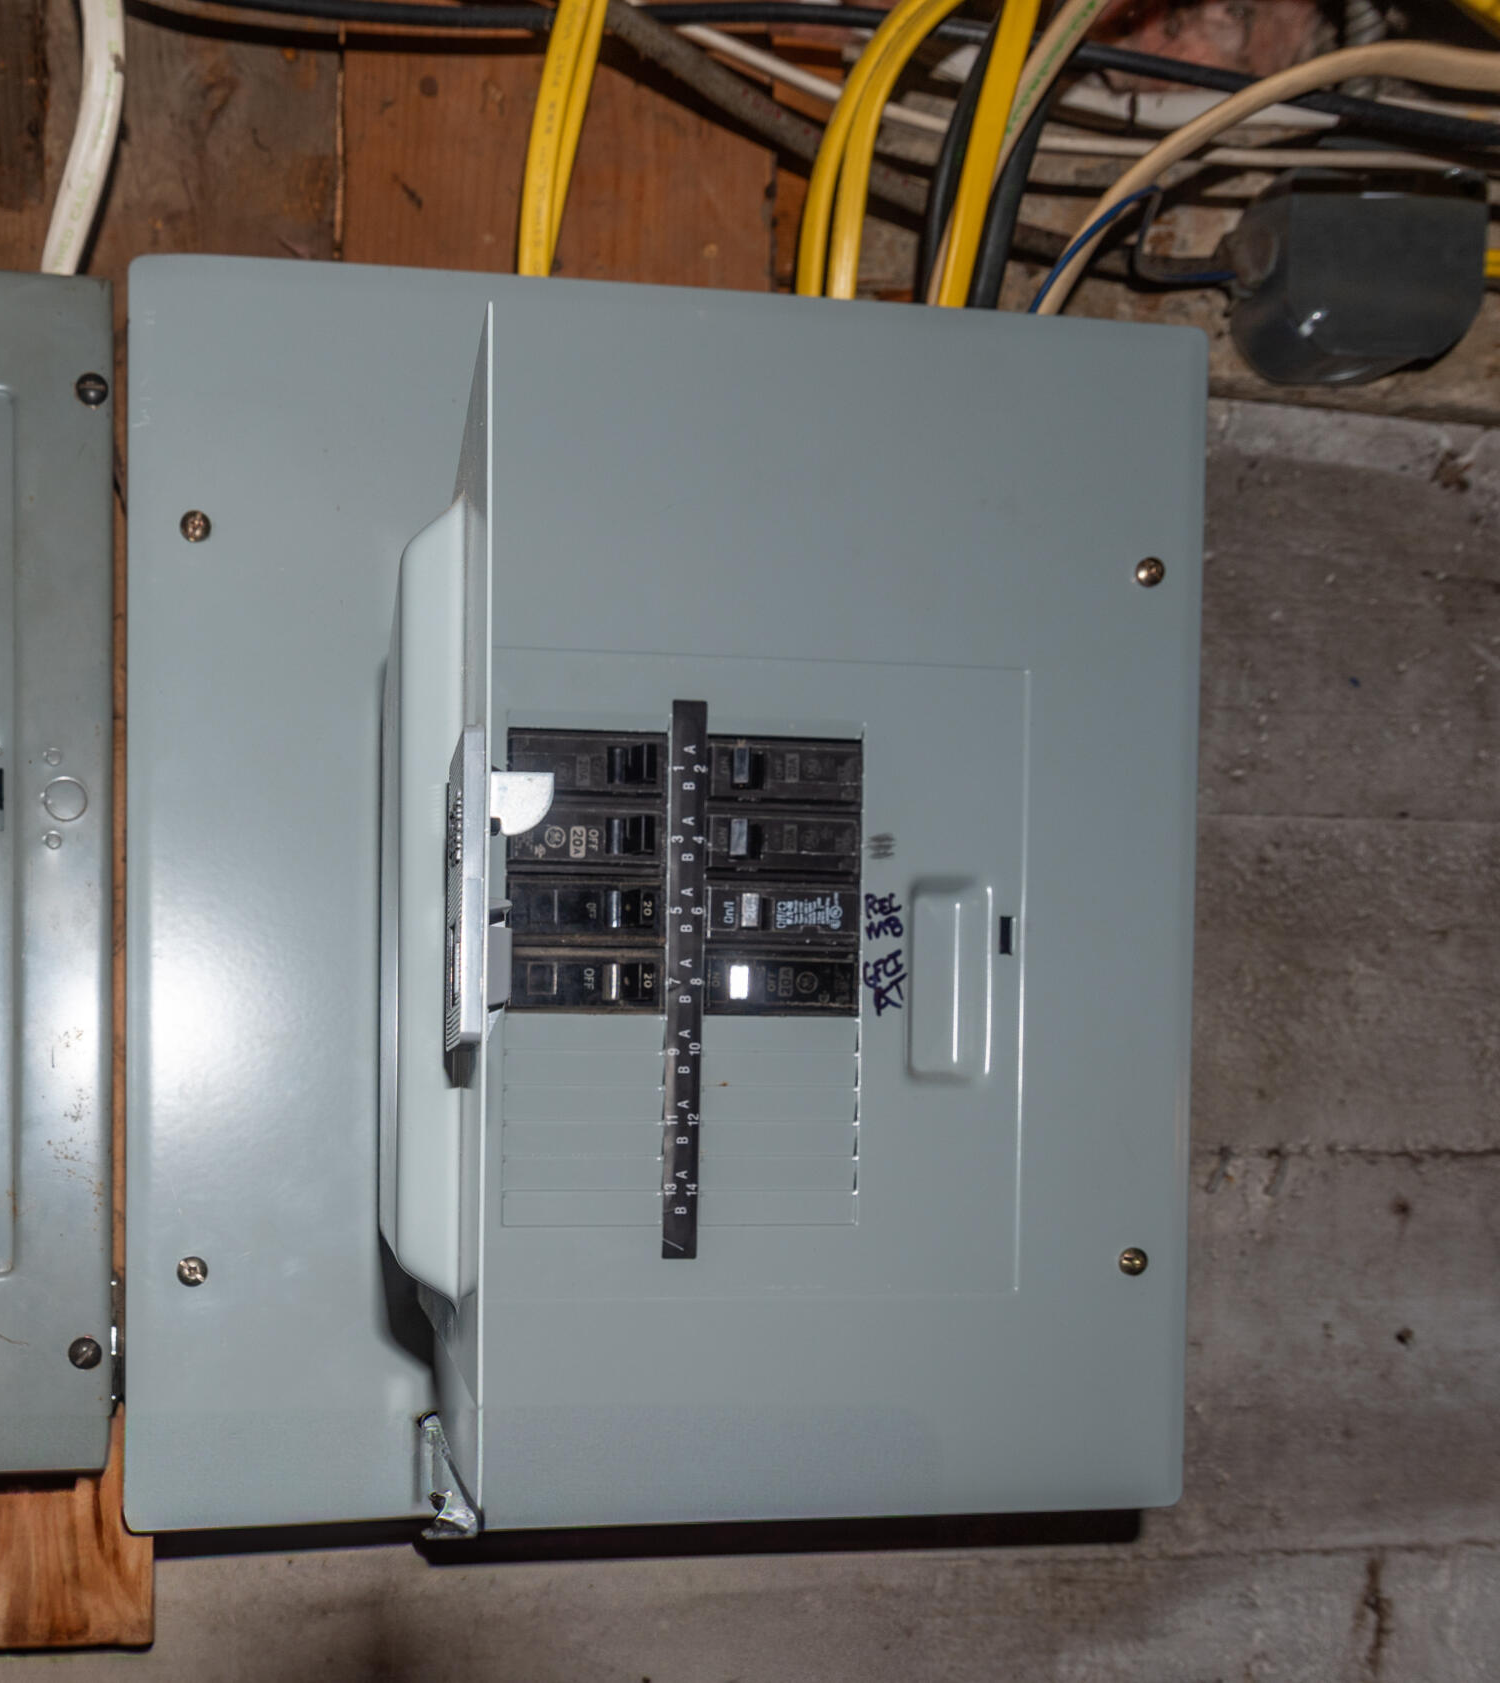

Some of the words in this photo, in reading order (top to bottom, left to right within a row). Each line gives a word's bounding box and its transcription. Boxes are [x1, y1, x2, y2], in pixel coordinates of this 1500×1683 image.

[684, 744, 696, 755] A
[673, 765, 685, 773] 1
[682, 816, 695, 826] A
[587, 828, 599, 852] OFF
[681, 853, 694, 862] B
[643, 900, 653, 917] 20
[670, 906, 683, 916] 5
[680, 924, 693, 933] B
[583, 967, 595, 991] OFF
[643, 972, 653, 989] 20
[690, 977, 703, 986] 8
[678, 1029, 691, 1039] A
[667, 1047, 680, 1057] 9
[687, 1113, 700, 1126] 12
[676, 1136, 689, 1145] B
[664, 1182, 677, 1196] 13
